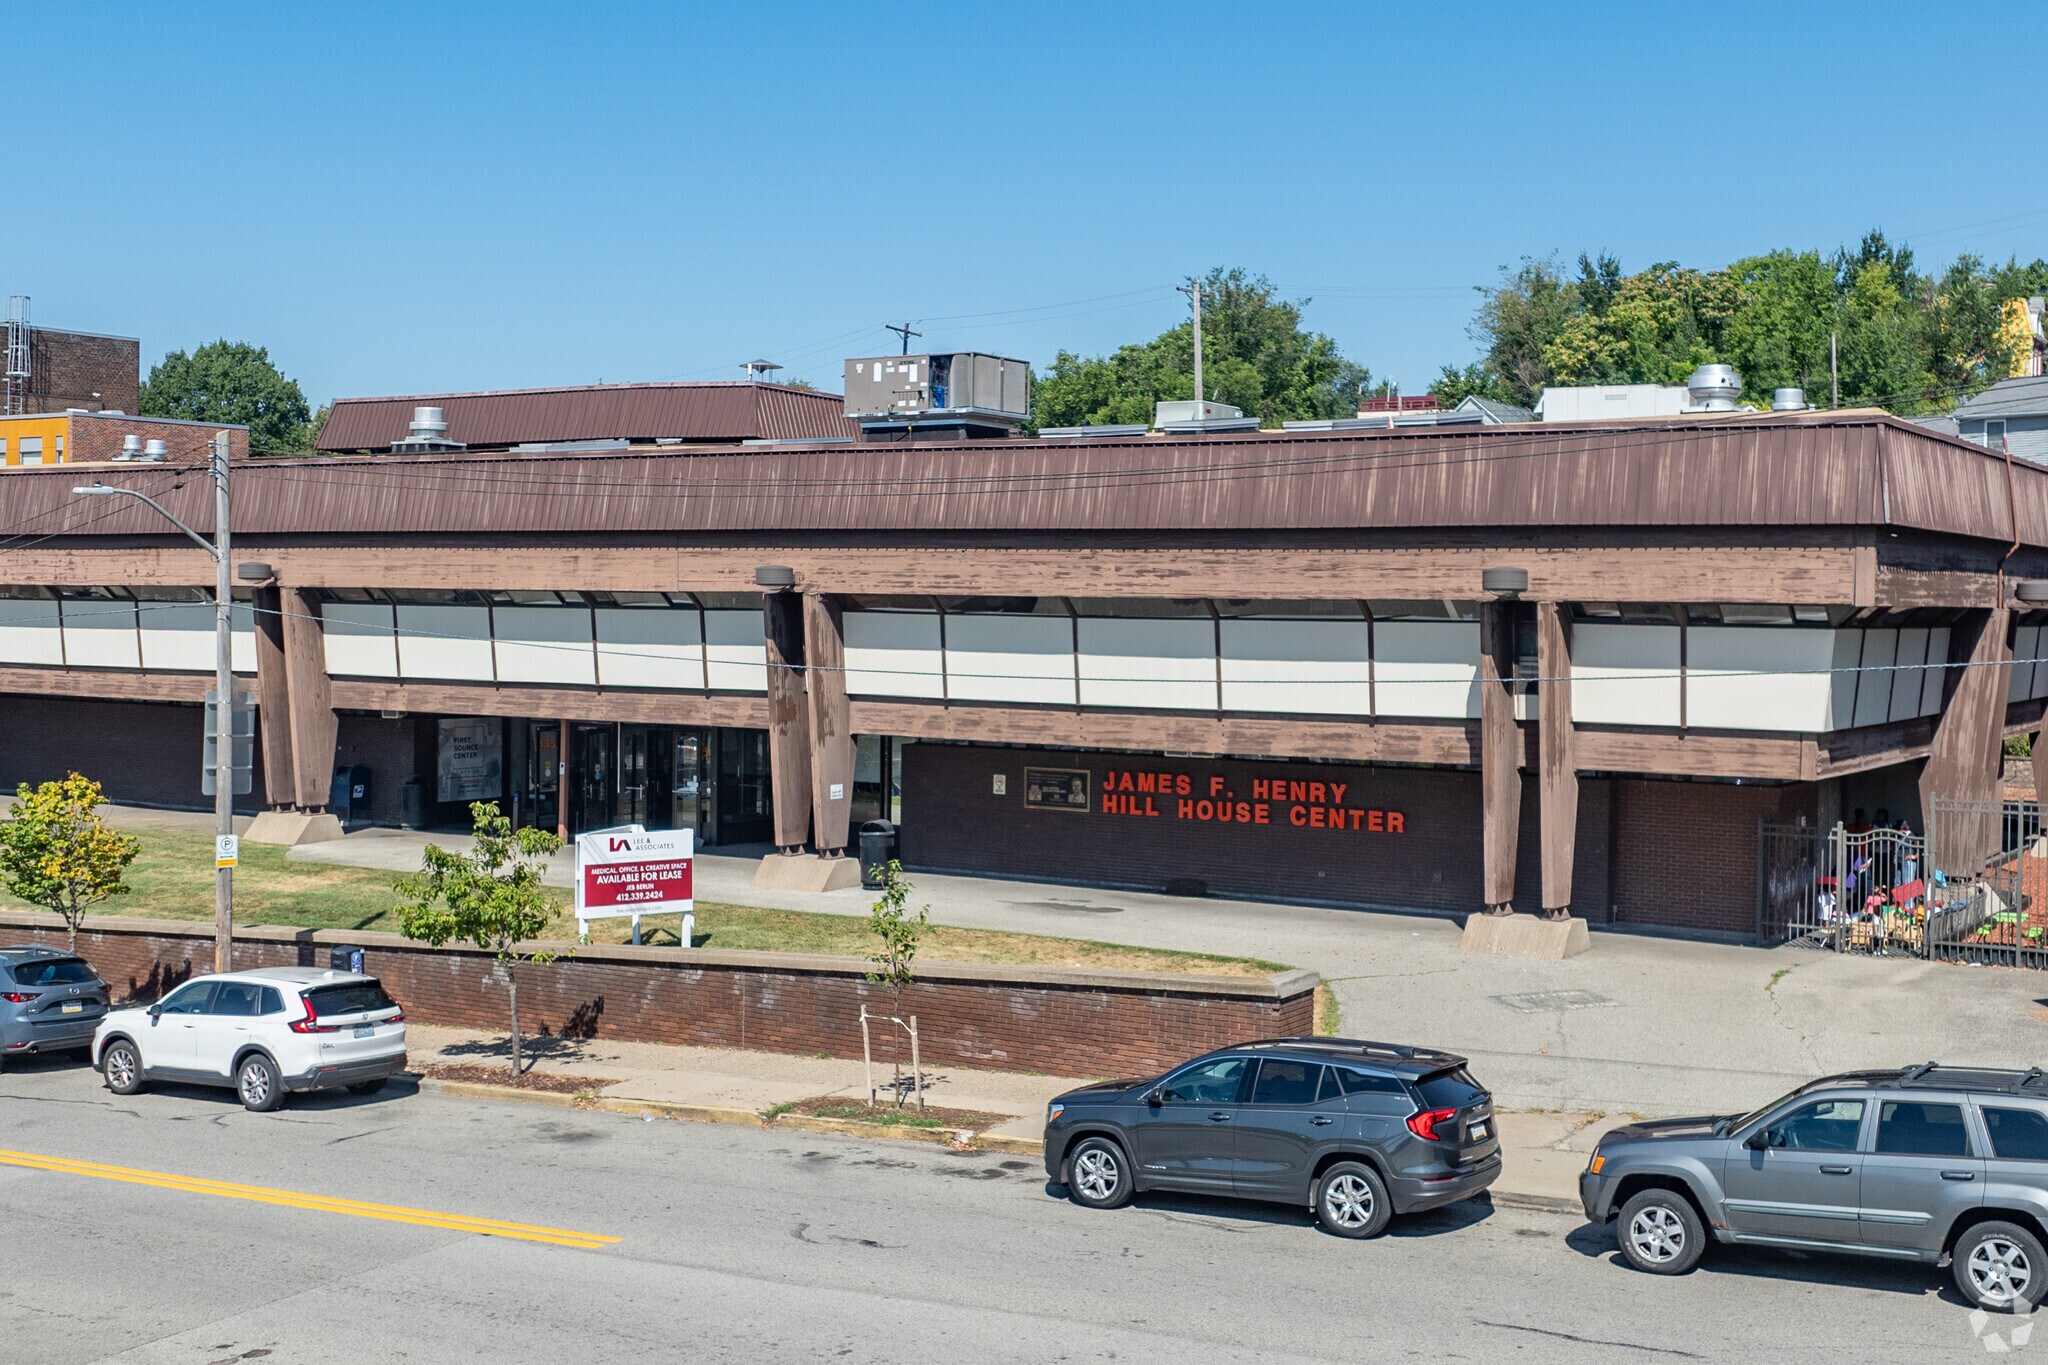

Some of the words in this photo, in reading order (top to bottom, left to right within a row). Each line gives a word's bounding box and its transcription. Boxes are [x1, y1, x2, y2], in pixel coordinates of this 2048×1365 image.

[1103, 771, 1192, 795] JAMES
[1210, 776, 1234, 797] F.
[1253, 779, 1347, 804] HENRY
[1102, 794, 1160, 817] HILL
[1178, 799, 1270, 824] HOUSE
[1289, 805, 1405, 833] CENTER
[635, 843, 675, 851] ASSOCIATES
[597, 872, 639, 884] AVAILABLE
[641, 871, 657, 881] FOR
[659, 870, 682, 879] LEASE
[636, 883, 654, 891] BERLIN
[616, 891, 663, 901] 412.339.2424
